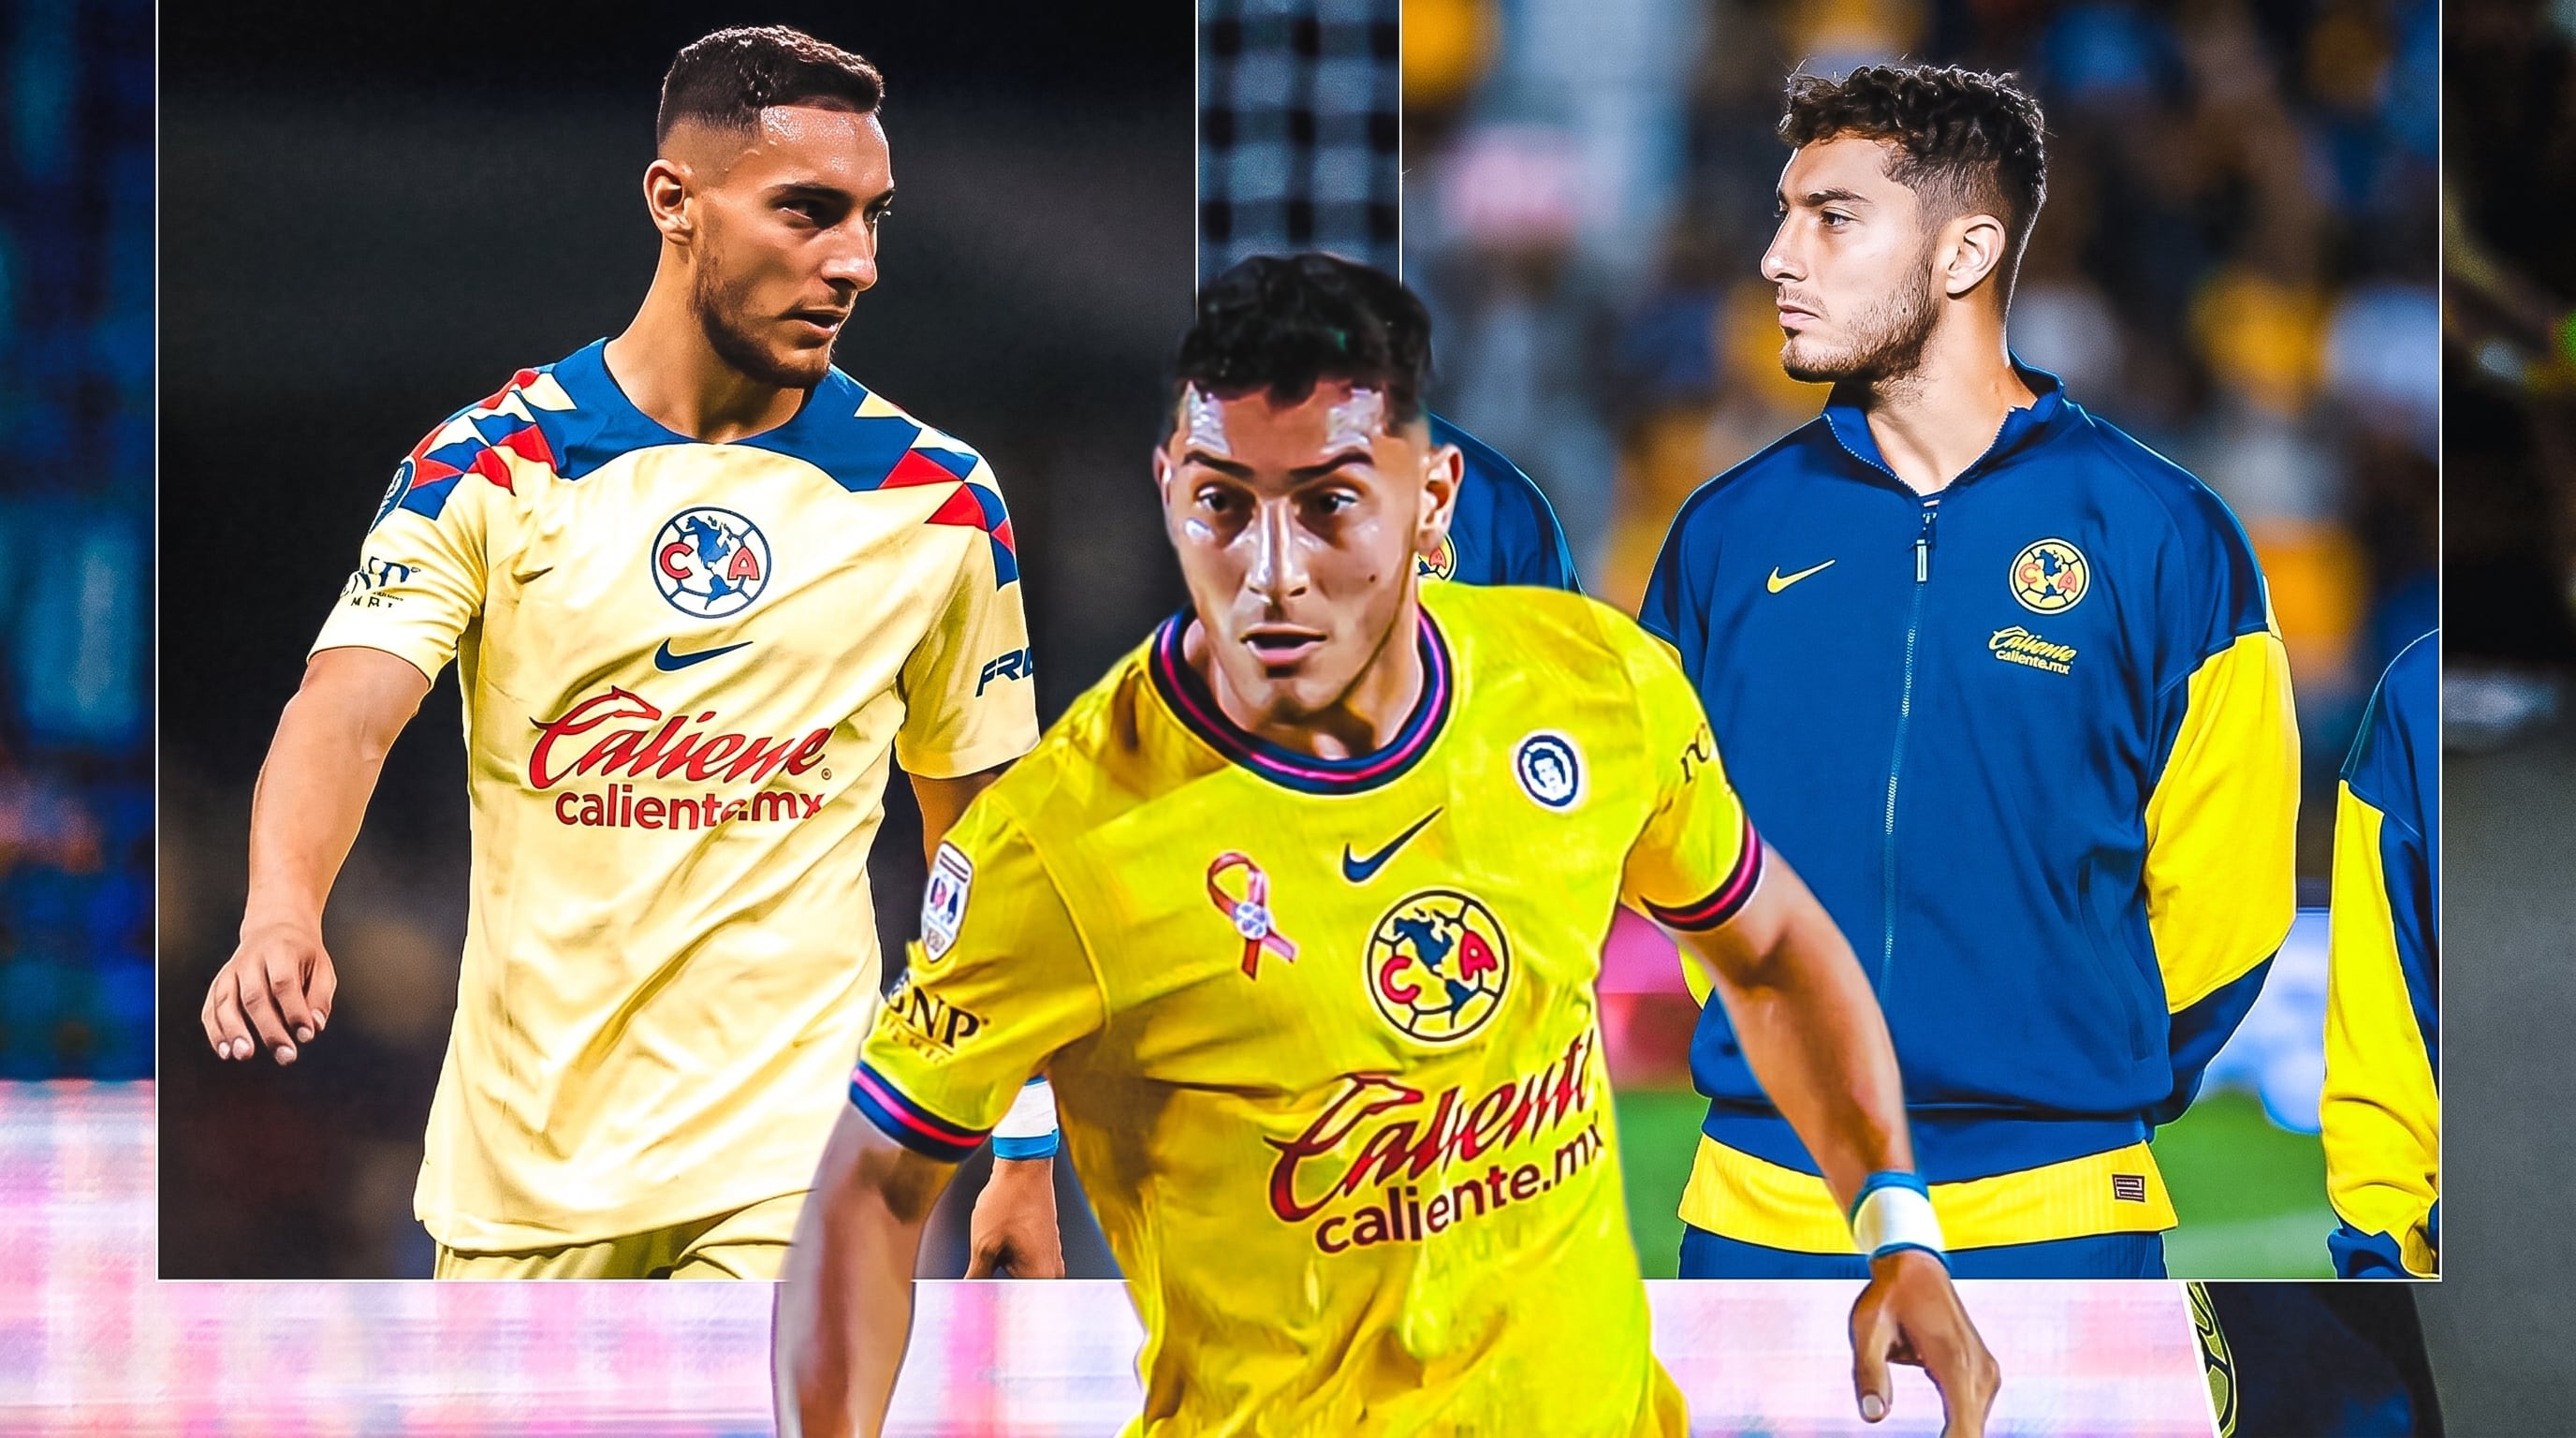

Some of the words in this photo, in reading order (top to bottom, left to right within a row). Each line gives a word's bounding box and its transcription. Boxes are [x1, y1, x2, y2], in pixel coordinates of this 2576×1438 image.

[660, 542, 694, 580] C
[726, 546, 760, 581] A
[2019, 563, 2041, 584] C
[2057, 569, 2077, 593] A
[1996, 650, 2071, 675] caliente.mx
[529, 685, 836, 789] Caliene
[1380, 956, 1421, 1005] C
[1458, 930, 1498, 981] A
[1263, 1028, 1594, 1223] Calient
